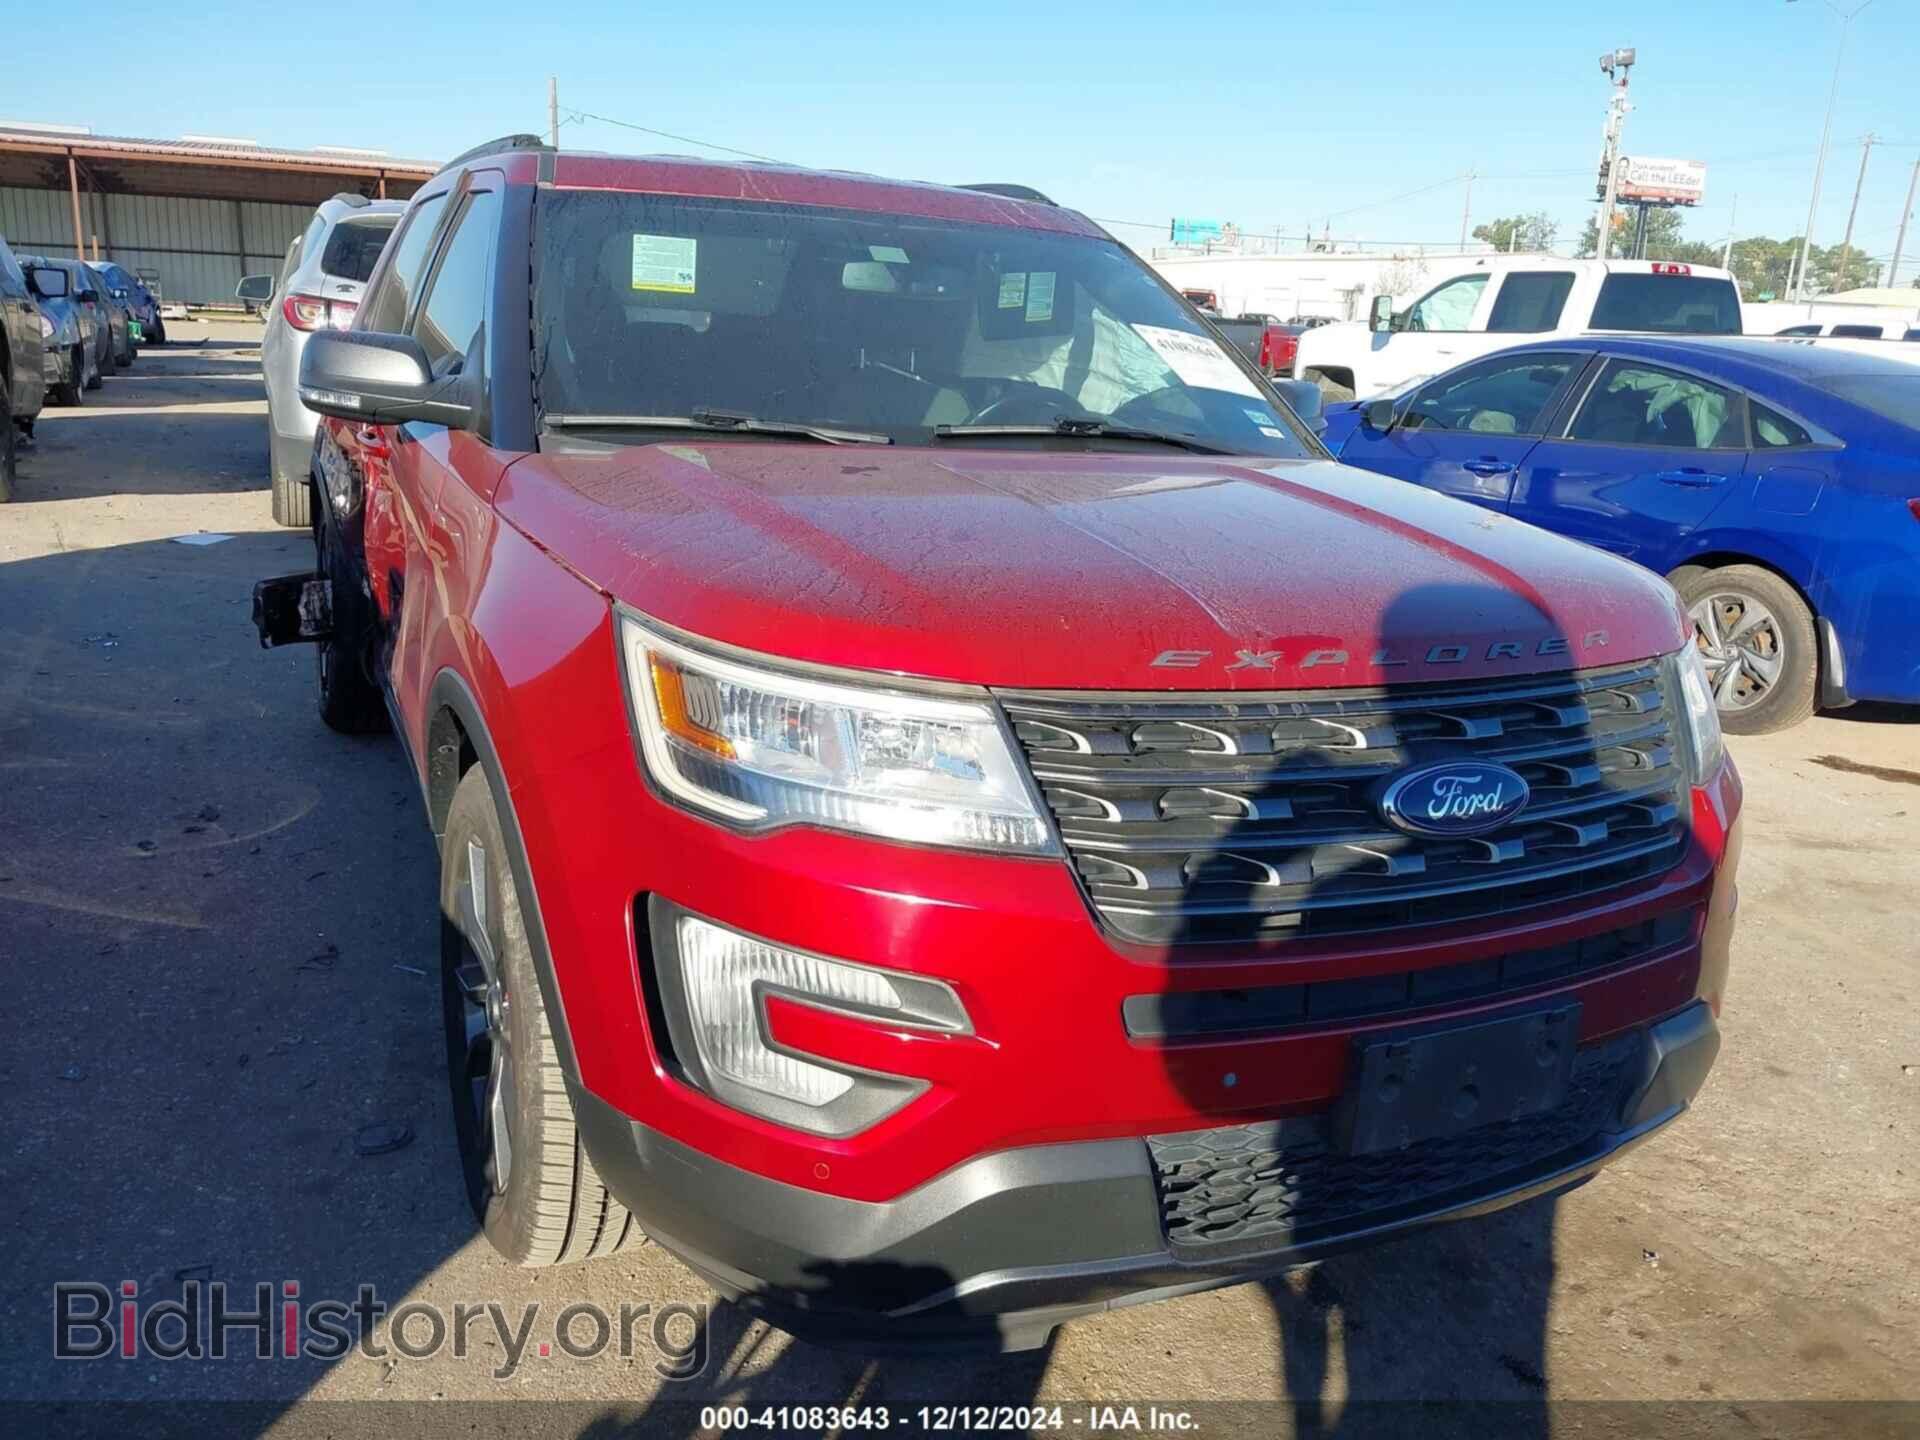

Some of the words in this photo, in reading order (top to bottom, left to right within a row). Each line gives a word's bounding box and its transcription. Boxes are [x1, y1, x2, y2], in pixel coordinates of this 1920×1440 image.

[1631, 169, 1648, 181] Call
[1650, 172, 1666, 183] the
[1151, 629, 1609, 671] EXPLORER
[1427, 775, 1504, 818] Ford
